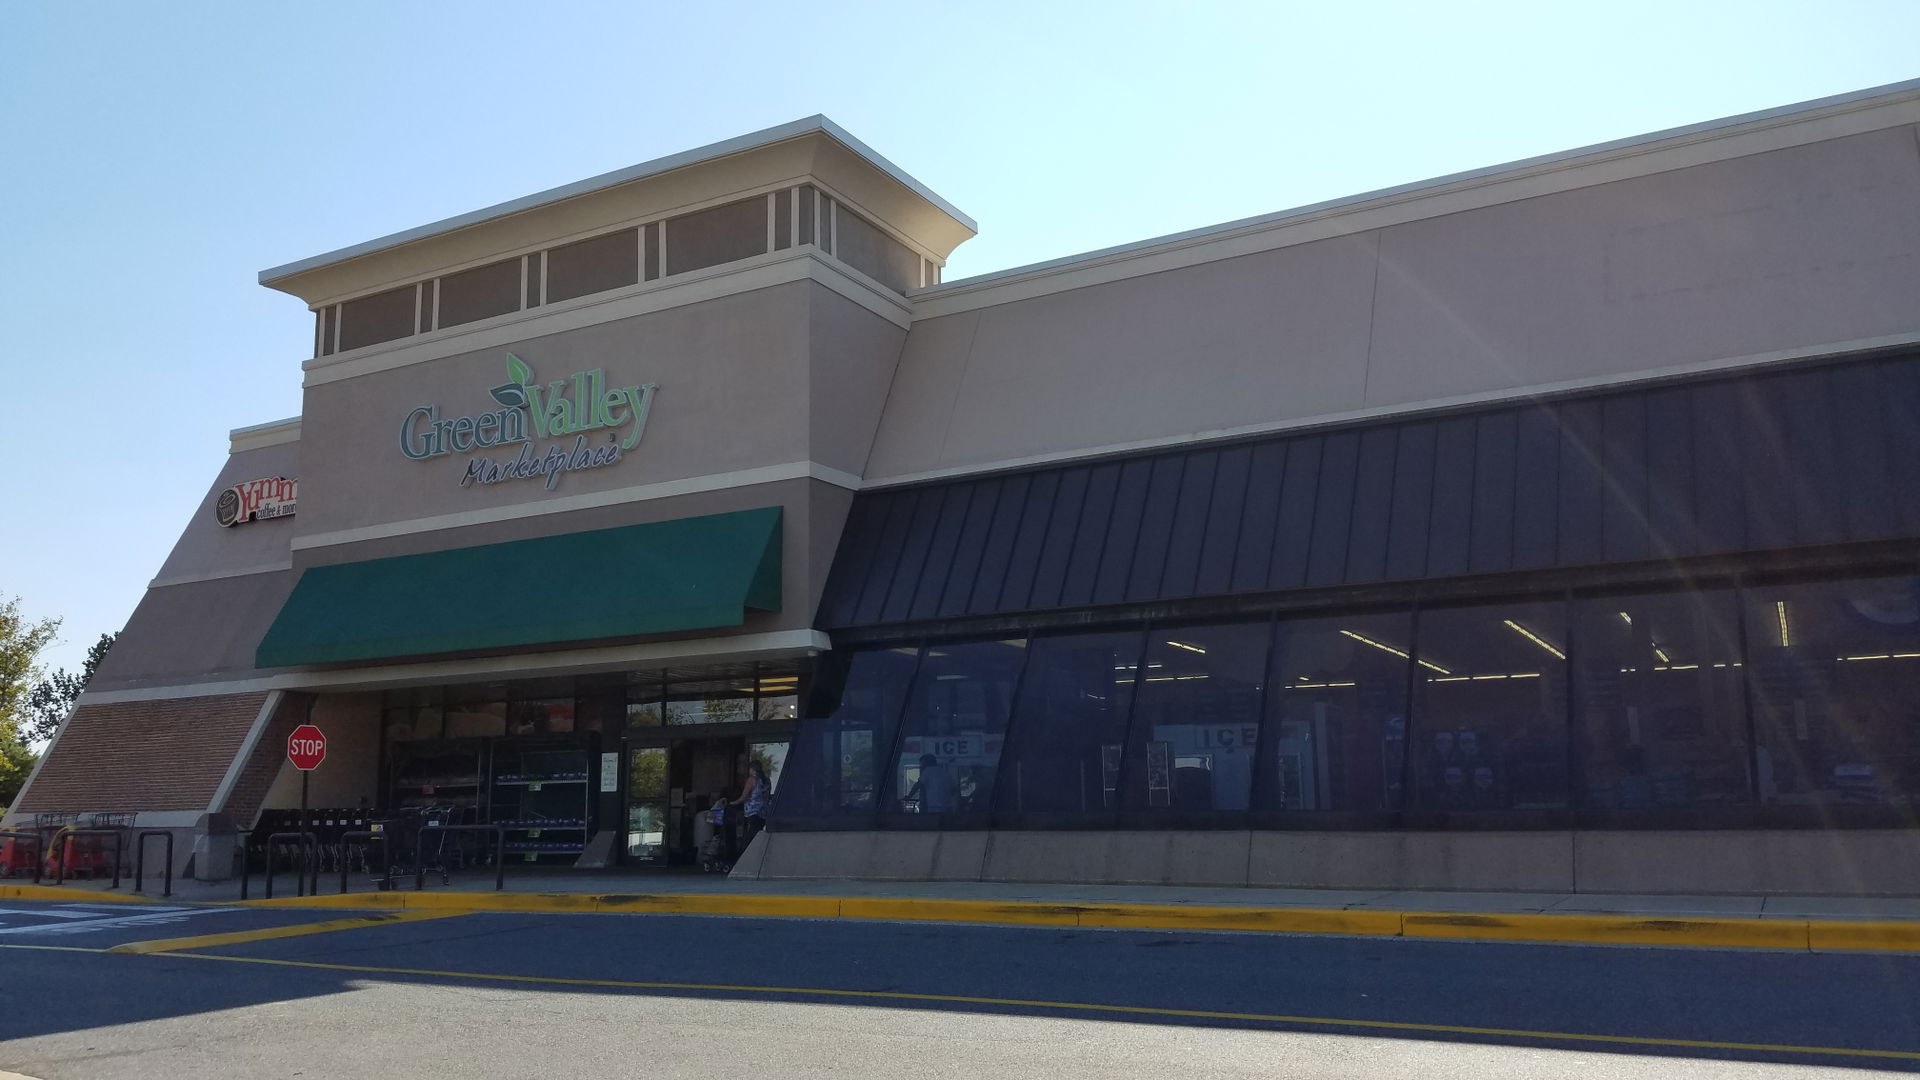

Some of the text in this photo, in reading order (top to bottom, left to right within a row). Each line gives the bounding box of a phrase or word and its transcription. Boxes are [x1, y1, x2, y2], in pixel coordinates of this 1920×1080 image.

[401, 368, 657, 460] Green Valley
[459, 435, 620, 489] Marketplace
[257, 502, 277, 518] coffee
[1203, 728, 1257, 746] ICE
[291, 739, 323, 756] STOP
[935, 740, 968, 755] ICE
